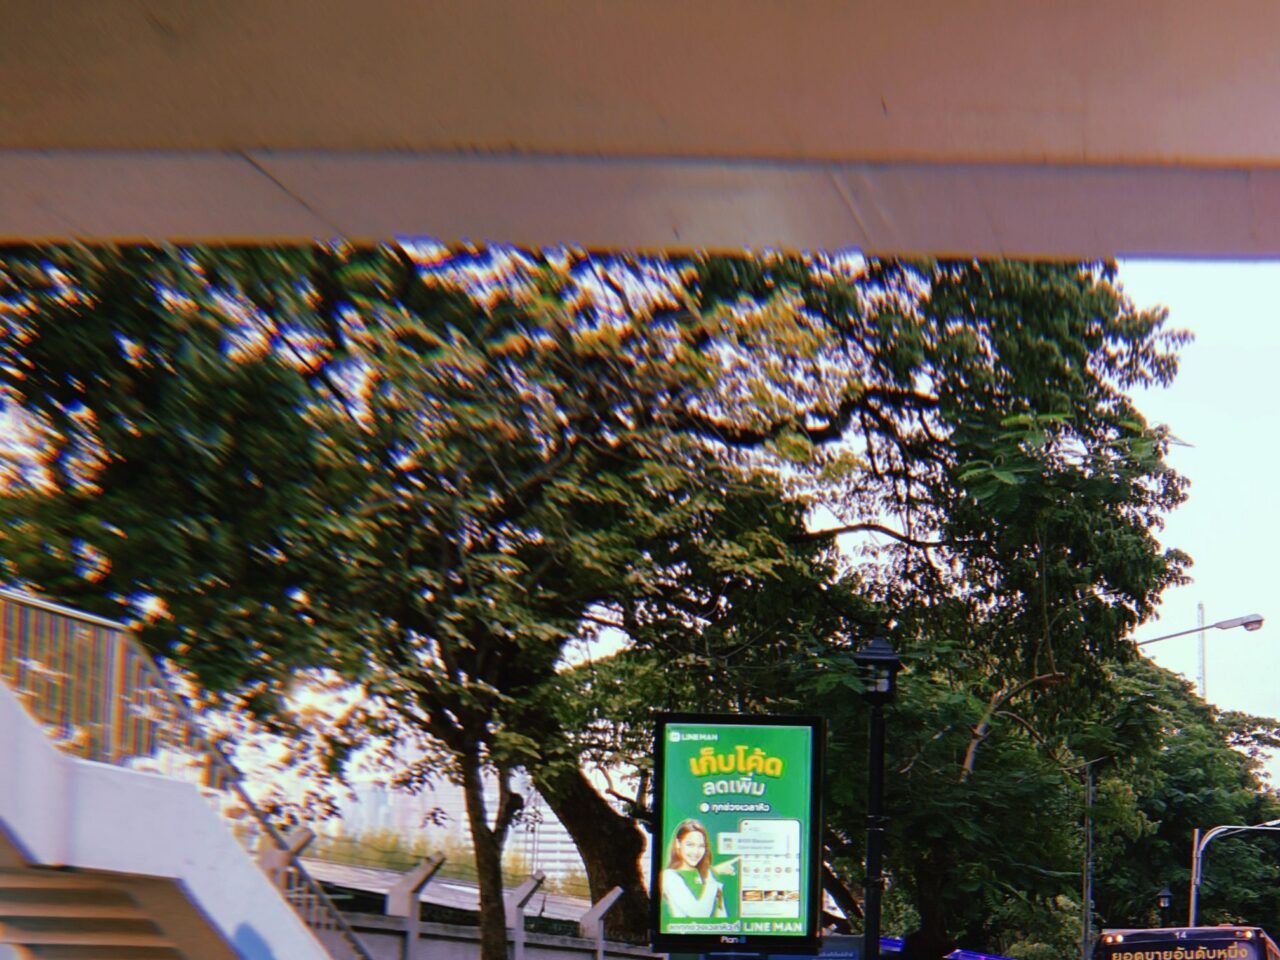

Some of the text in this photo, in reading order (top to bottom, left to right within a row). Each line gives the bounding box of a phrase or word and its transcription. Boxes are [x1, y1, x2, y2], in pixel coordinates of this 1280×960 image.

[690, 745, 783, 776] เก็บโค้ด
[703, 773, 765, 796] ลดเพิ่ม
[744, 922, 771, 932] LINE
[774, 922, 803, 933] MAN
[1175, 931, 1187, 939] 14
[1112, 942, 1248, 960] ยอดขายอันดับหนึ่ง
